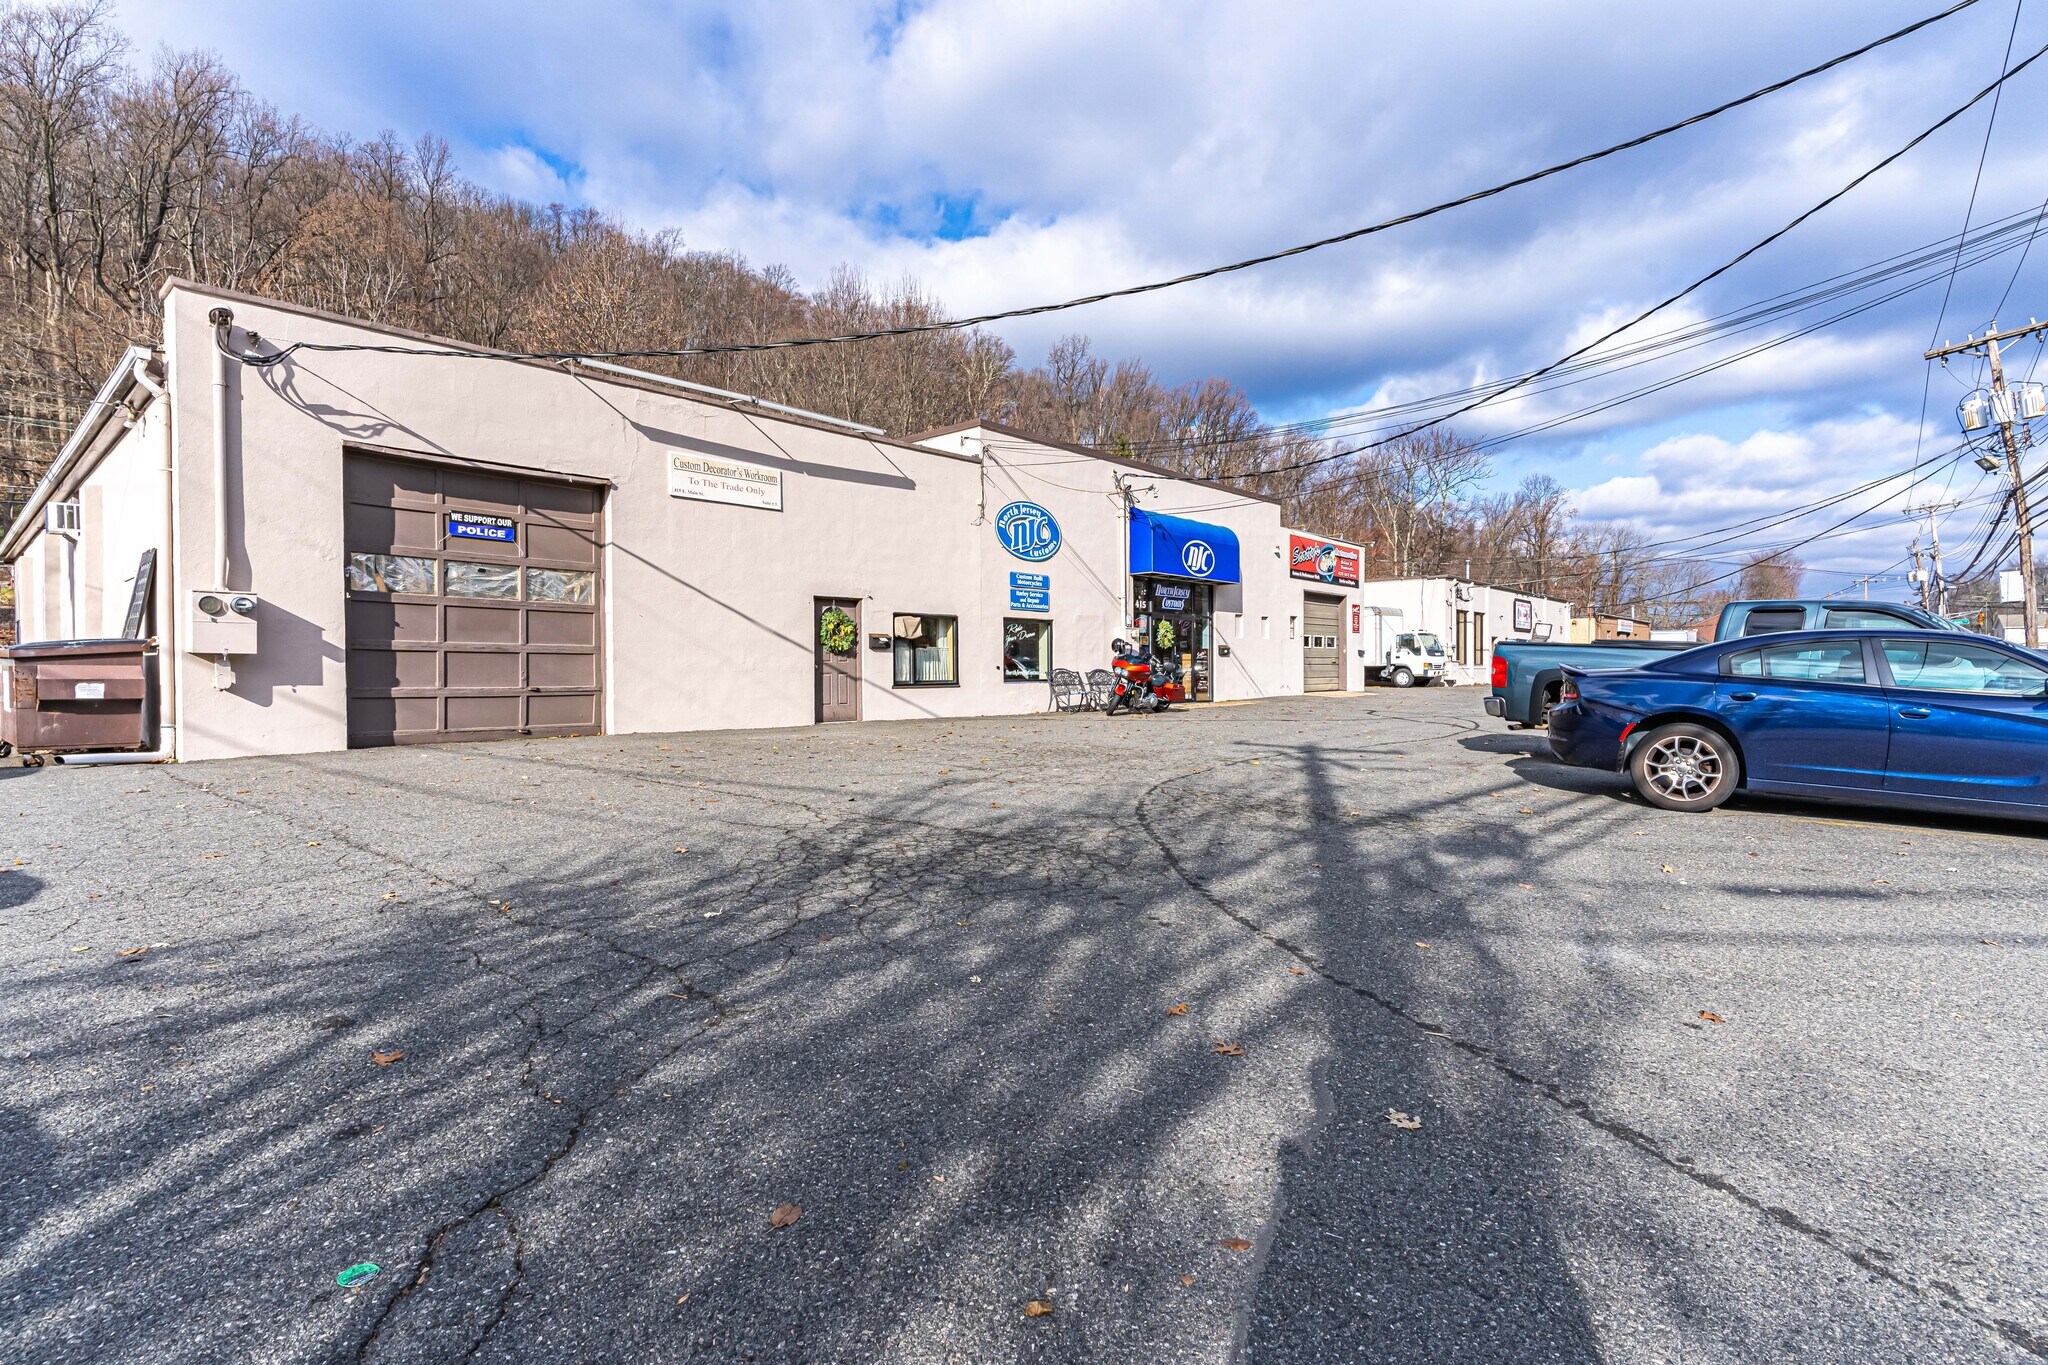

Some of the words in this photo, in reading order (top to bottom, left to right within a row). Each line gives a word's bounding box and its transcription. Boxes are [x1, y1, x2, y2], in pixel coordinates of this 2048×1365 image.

[673, 457, 701, 472] Custom
[703, 461, 743, 478] Decorator's
[744, 469, 778, 484] Workroom
[688, 477, 700, 486] To
[702, 478, 718, 489] The
[720, 481, 744, 493] Trade
[745, 486, 766, 497] Only
[1020, 504, 1042, 518] Jersey
[451, 512, 463, 522] WE
[463, 514, 496, 526] SUPPORT
[497, 518, 513, 528] OUR
[457, 525, 506, 539] POLICE
[1030, 540, 1058, 557] Customs
[1015, 573, 1033, 581] Custom
[1017, 579, 1043, 588] Motorcycles
[1029, 591, 1044, 599] Service
[1135, 599, 1147, 609] 415
